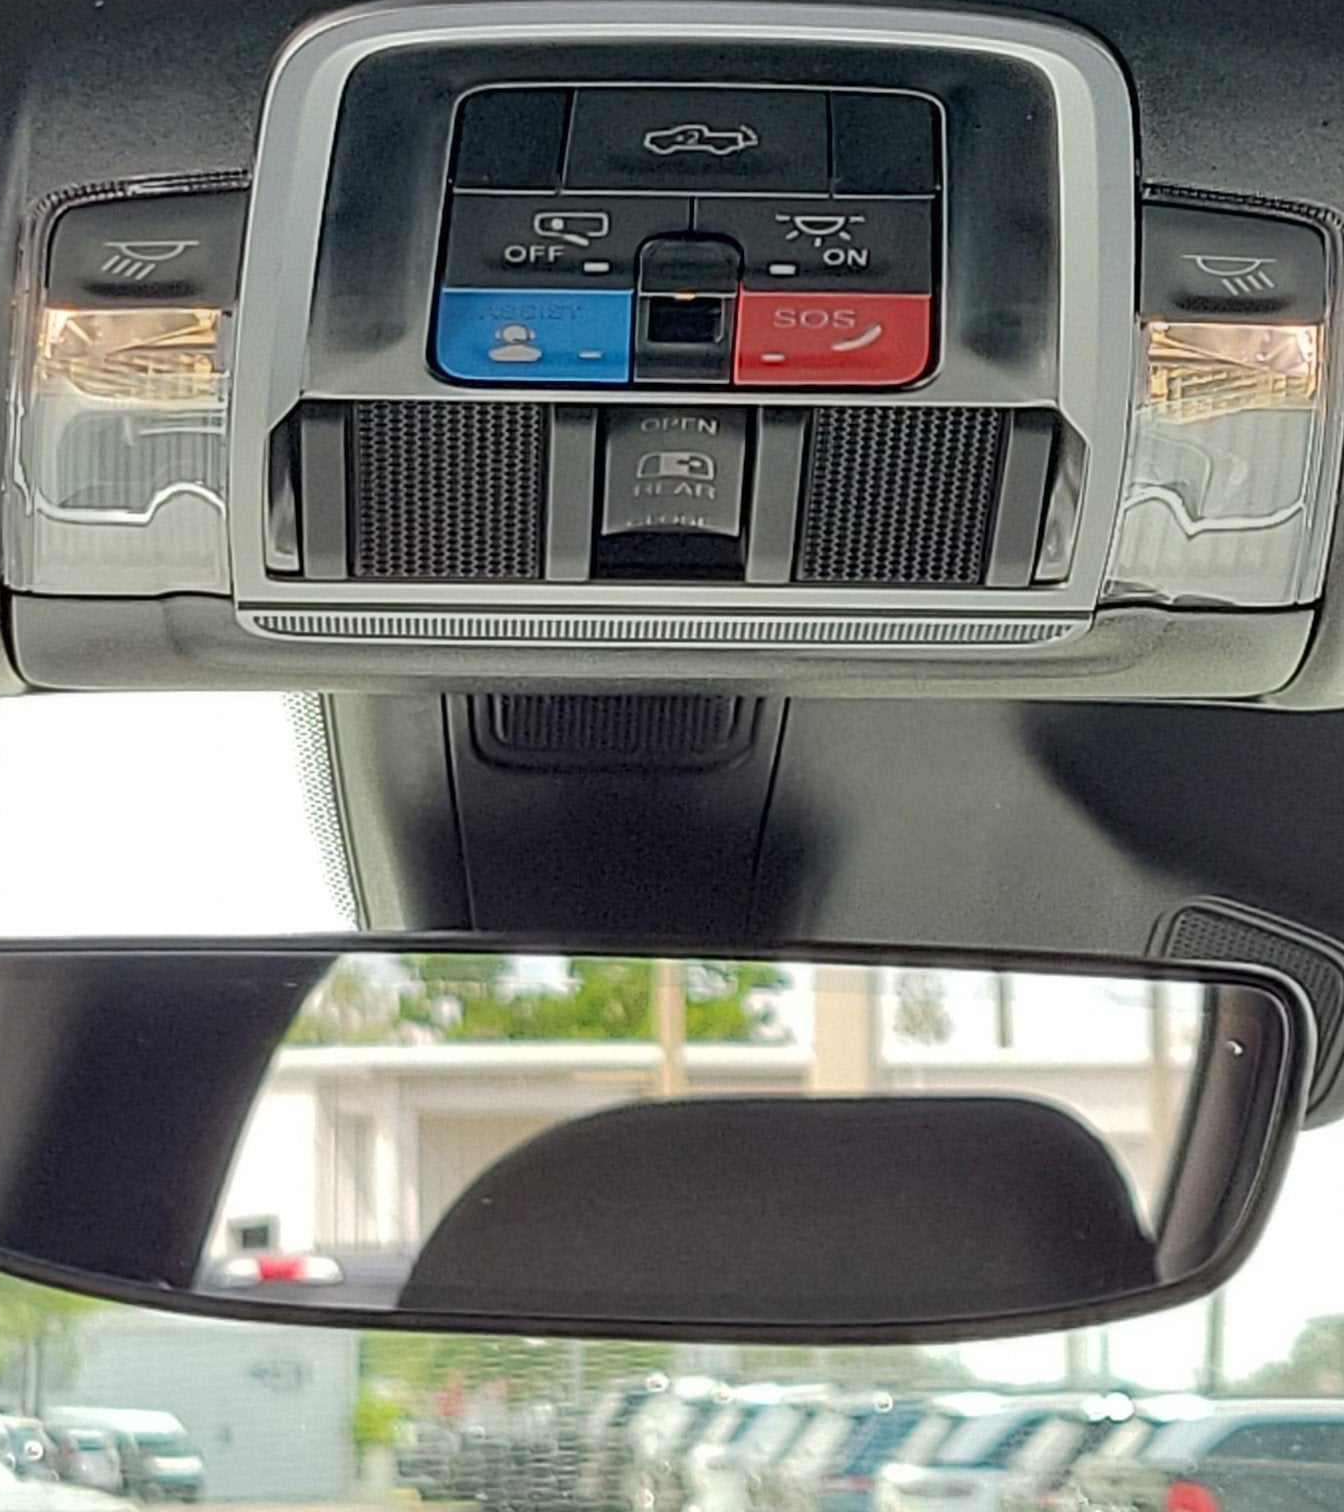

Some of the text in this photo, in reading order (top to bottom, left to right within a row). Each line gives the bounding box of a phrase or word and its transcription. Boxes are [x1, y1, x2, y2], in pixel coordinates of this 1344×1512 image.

[505, 245, 564, 262] OFF
[823, 248, 868, 266] ON
[773, 308, 857, 330] SOS
[640, 416, 718, 436] OPEN
